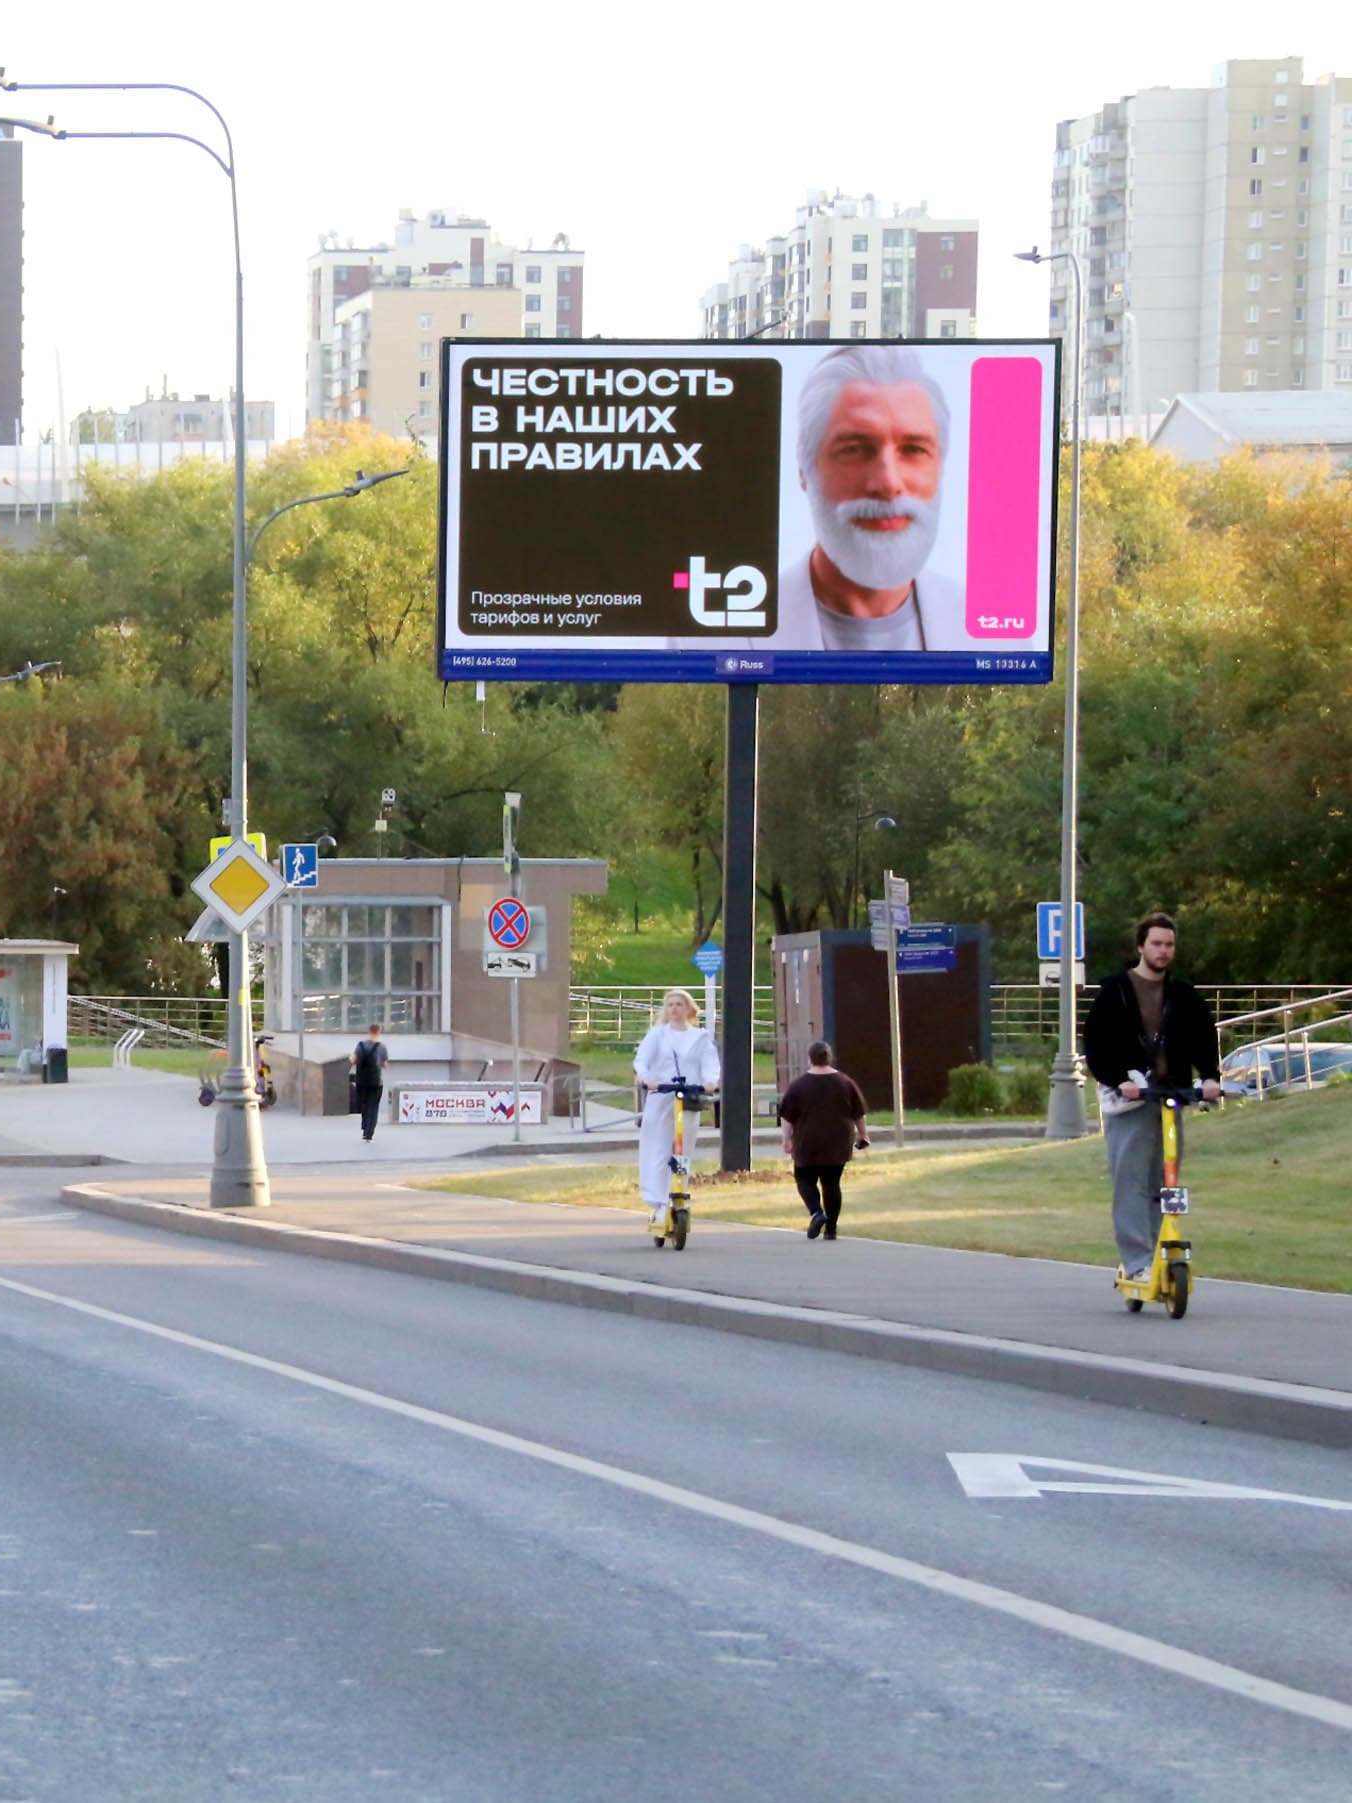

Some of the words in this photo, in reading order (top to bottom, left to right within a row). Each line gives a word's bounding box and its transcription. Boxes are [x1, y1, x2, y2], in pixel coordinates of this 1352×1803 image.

[472, 368, 734, 397] ЧЕСТНОСТЬ
[472, 405, 499, 433] В
[516, 405, 677, 433] НАШИХ
[471, 442, 703, 470] ПРАВИЛАХ
[471, 590, 573, 608] Прозрачные
[575, 593, 643, 608] условия
[674, 556, 767, 628] t2
[471, 610, 540, 628] тарифов
[543, 612, 554, 624] и
[557, 612, 602, 628] услуг
[976, 615, 1025, 629] t2.ru
[739, 659, 764, 670] Russ
[425, 1099, 486, 1108] МОСКВА
